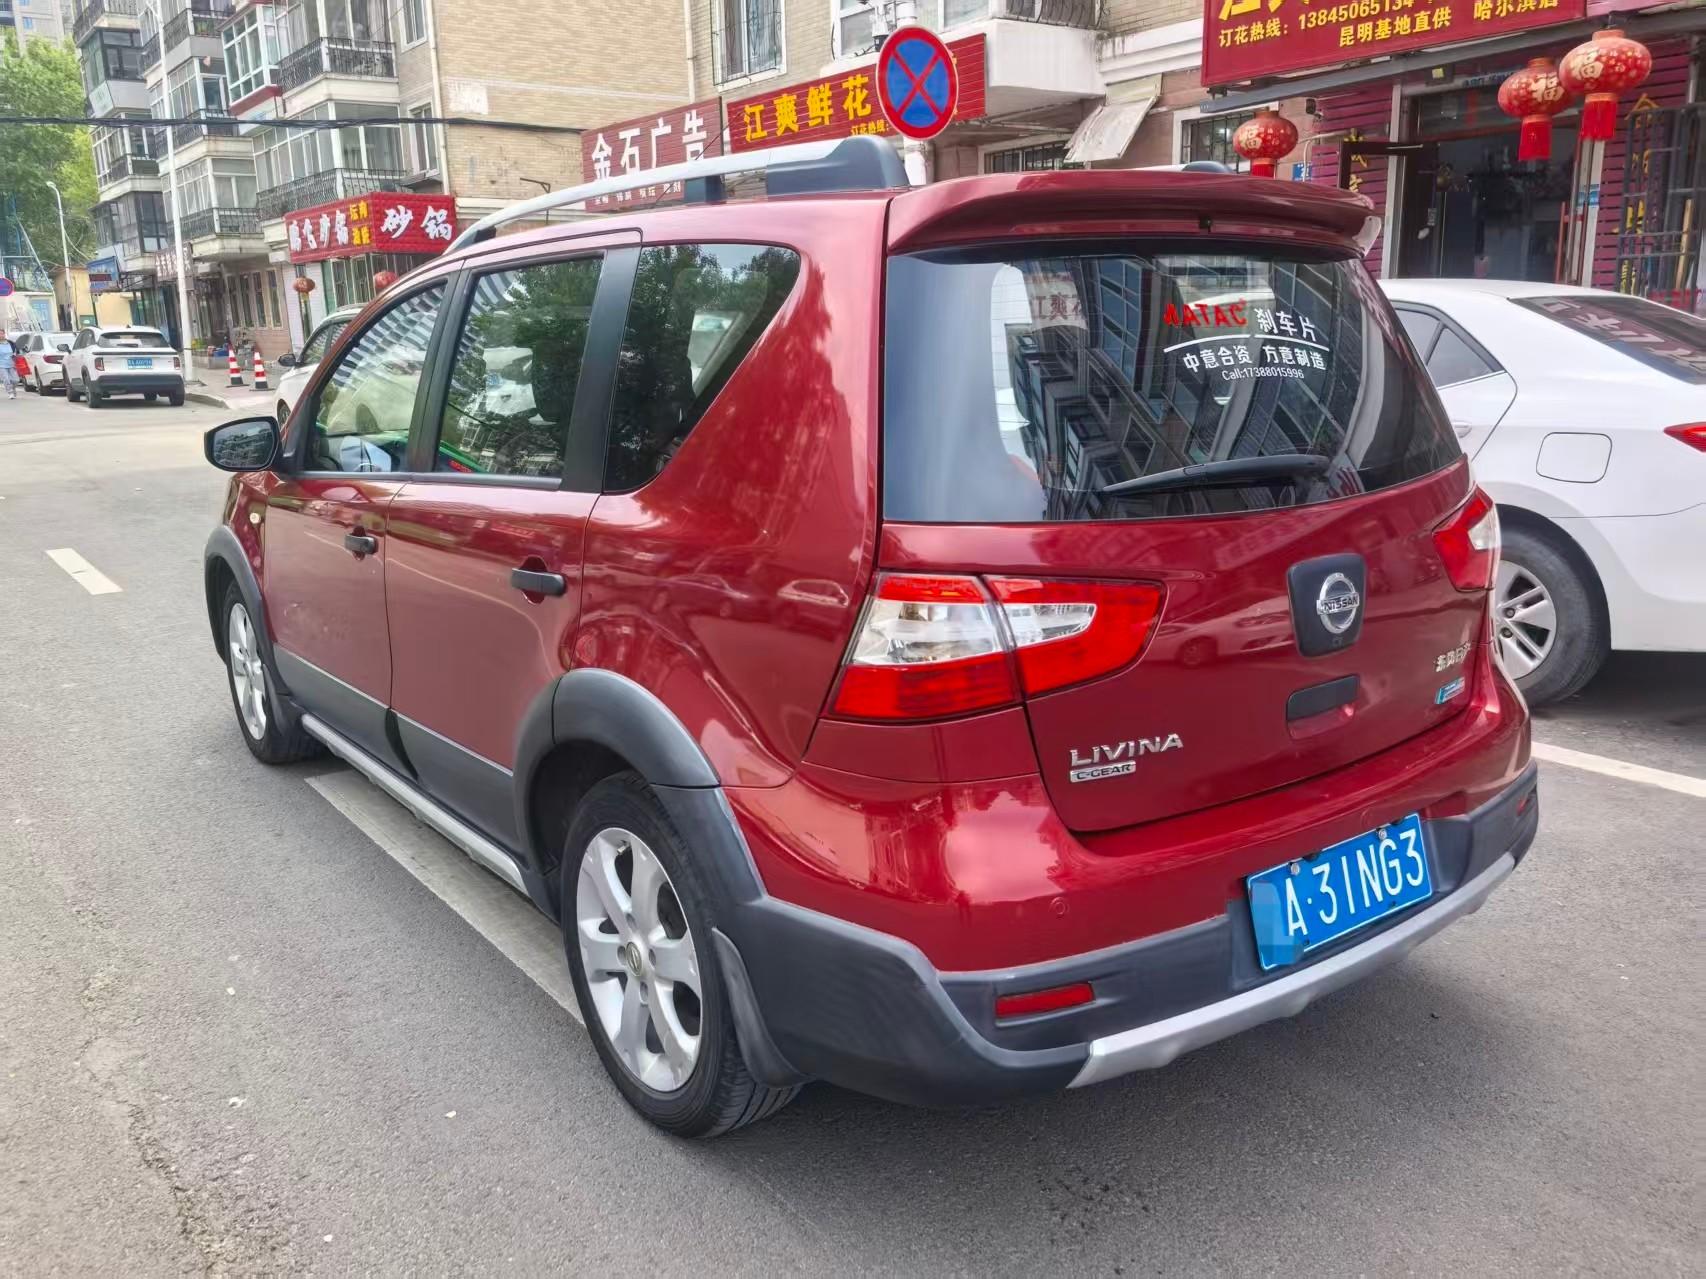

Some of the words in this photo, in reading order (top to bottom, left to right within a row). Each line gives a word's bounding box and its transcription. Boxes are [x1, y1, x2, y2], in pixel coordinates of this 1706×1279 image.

[1339, 6, 1452, 47] 昆明基地直供
[743, 73, 873, 142] 江爽鲜花
[591, 109, 708, 181] 金石广告
[1254, 307, 1317, 342] 刹车片
[1183, 345, 1253, 373] 中意合资
[1323, 592, 1359, 613] NISSAN
[1069, 733, 1184, 767] LIVINA
[1075, 762, 1133, 781] C-GEAR
